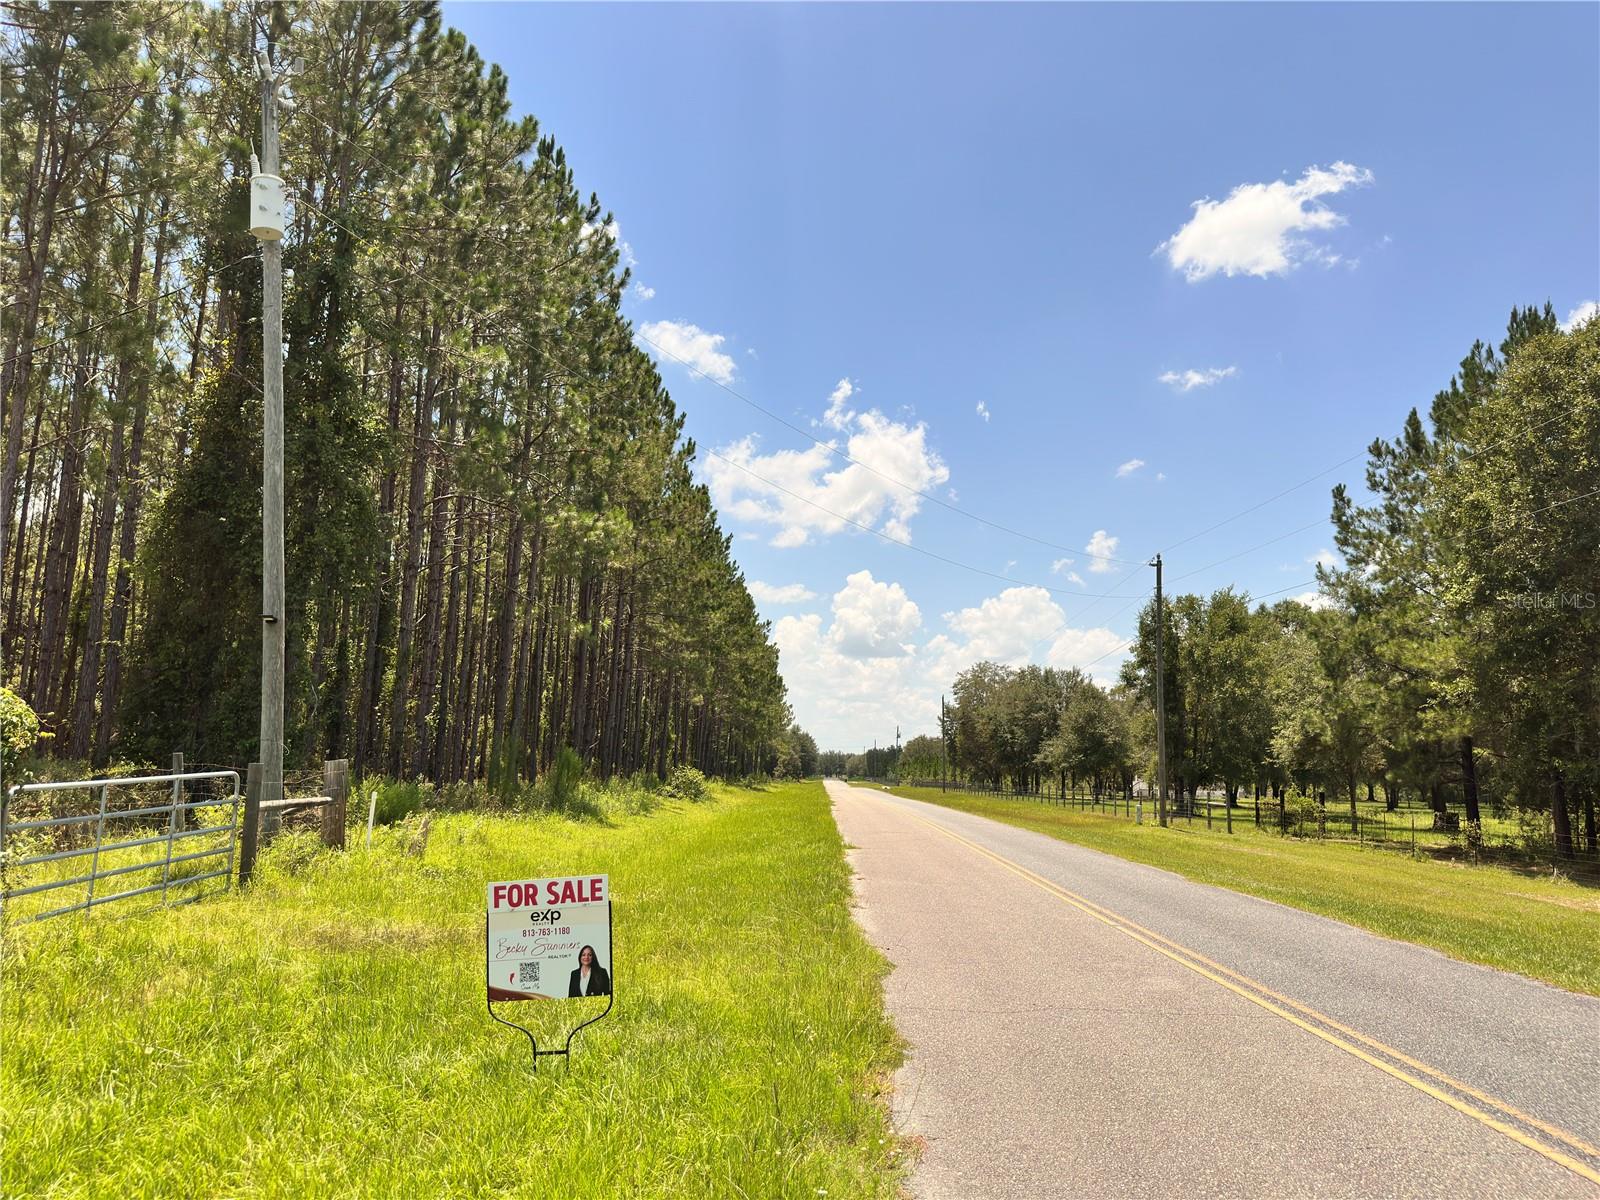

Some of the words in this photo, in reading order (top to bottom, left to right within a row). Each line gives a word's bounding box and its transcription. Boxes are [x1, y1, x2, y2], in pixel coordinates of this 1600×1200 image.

[493, 883, 539, 909] FOR
[546, 878, 604, 906] SALE
[522, 926, 571, 938] 813-763-1180
[496, 937, 528, 960] Becky
